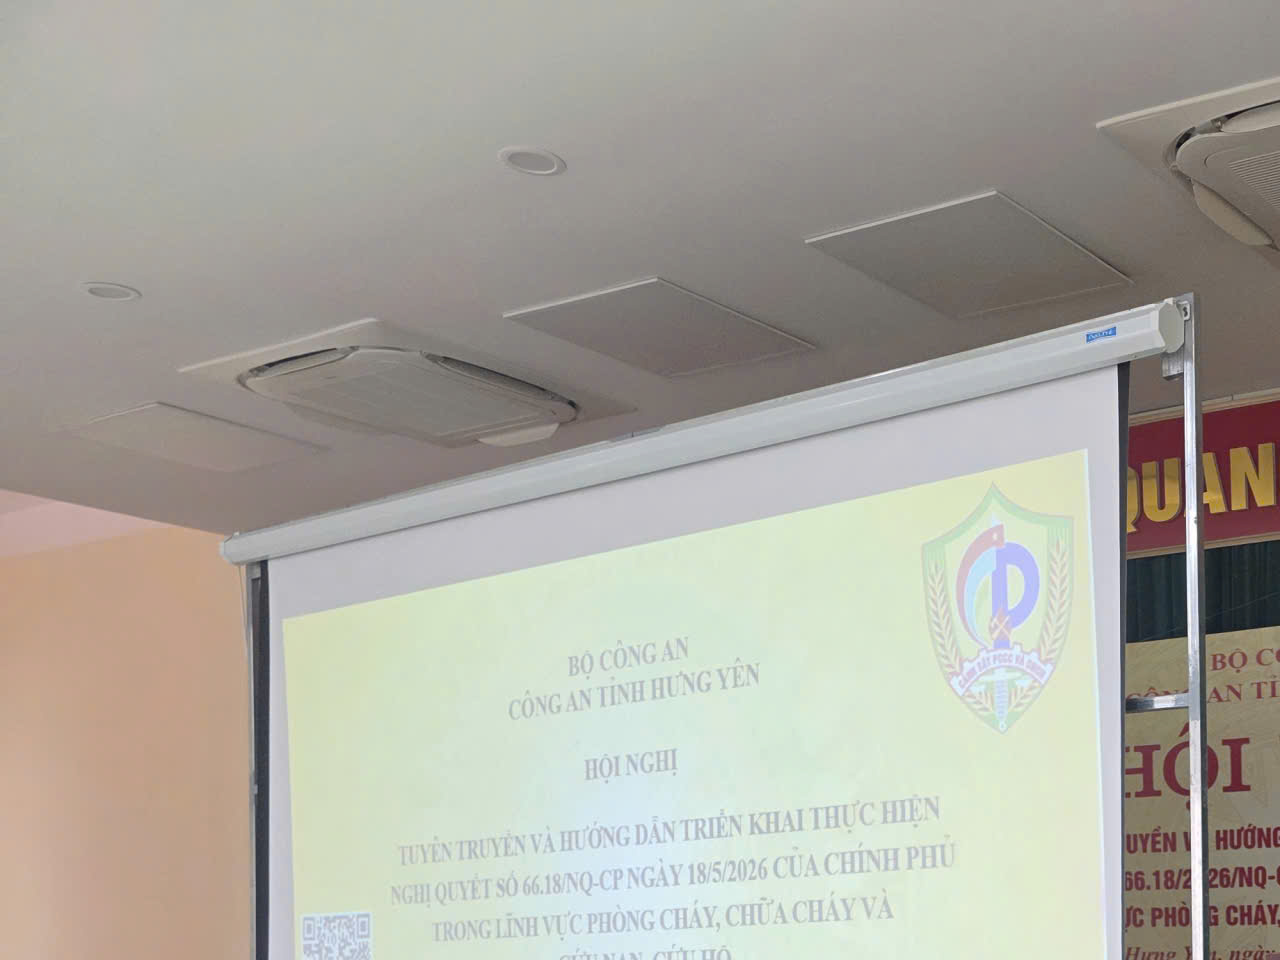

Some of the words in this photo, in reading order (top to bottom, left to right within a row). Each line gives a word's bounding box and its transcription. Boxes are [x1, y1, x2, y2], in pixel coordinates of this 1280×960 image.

[568, 651, 593, 680] BỘ
[600, 640, 656, 671] CÔNG
[661, 637, 689, 662] AN
[1210, 648, 1248, 673] BỘ
[509, 690, 561, 720] CÔNG
[565, 688, 591, 712] AN
[597, 676, 645, 709] TỈNH
[651, 671, 711, 700] HƯNG
[717, 657, 760, 690] YÊN
[1208, 684, 1242, 703] AN
[584, 753, 620, 783] HỘI
[626, 748, 677, 776] NGHỊ
[398, 835, 452, 865] TUYÊN
[455, 830, 526, 860] TRUYỀN
[529, 826, 556, 853] VÀ
[560, 821, 630, 851] HƯỚNG
[635, 816, 675, 846] DẪN
[680, 808, 743, 842] TRIỂN
[748, 808, 804, 836] KHAI
[809, 800, 875, 833] THỰC
[880, 794, 941, 828] HIỆN
[392, 883, 431, 908] NGHỊ
[435, 874, 492, 905] QUYẾT
[496, 870, 518, 898] SỐ
[522, 868, 623, 896] 66.18/NQ-CP
[627, 858, 683, 889] NGÀY
[688, 857, 768, 886] 18/5/2026
[773, 846, 820, 879] CỦA
[824, 842, 900, 875] CHÍNH
[905, 834, 956, 870] PHỦ
[432, 919, 491, 942] TRONG
[496, 913, 538, 938] LĨNH
[543, 912, 582, 941] VỰC
[587, 904, 655, 934] PHÒNG
[659, 900, 721, 932] CHÁY,
[725, 897, 788, 927] CHỮA
[792, 891, 856, 924] CHÁY
[861, 888, 894, 920] VÀ
[1151, 901, 1219, 928] PHÒG
